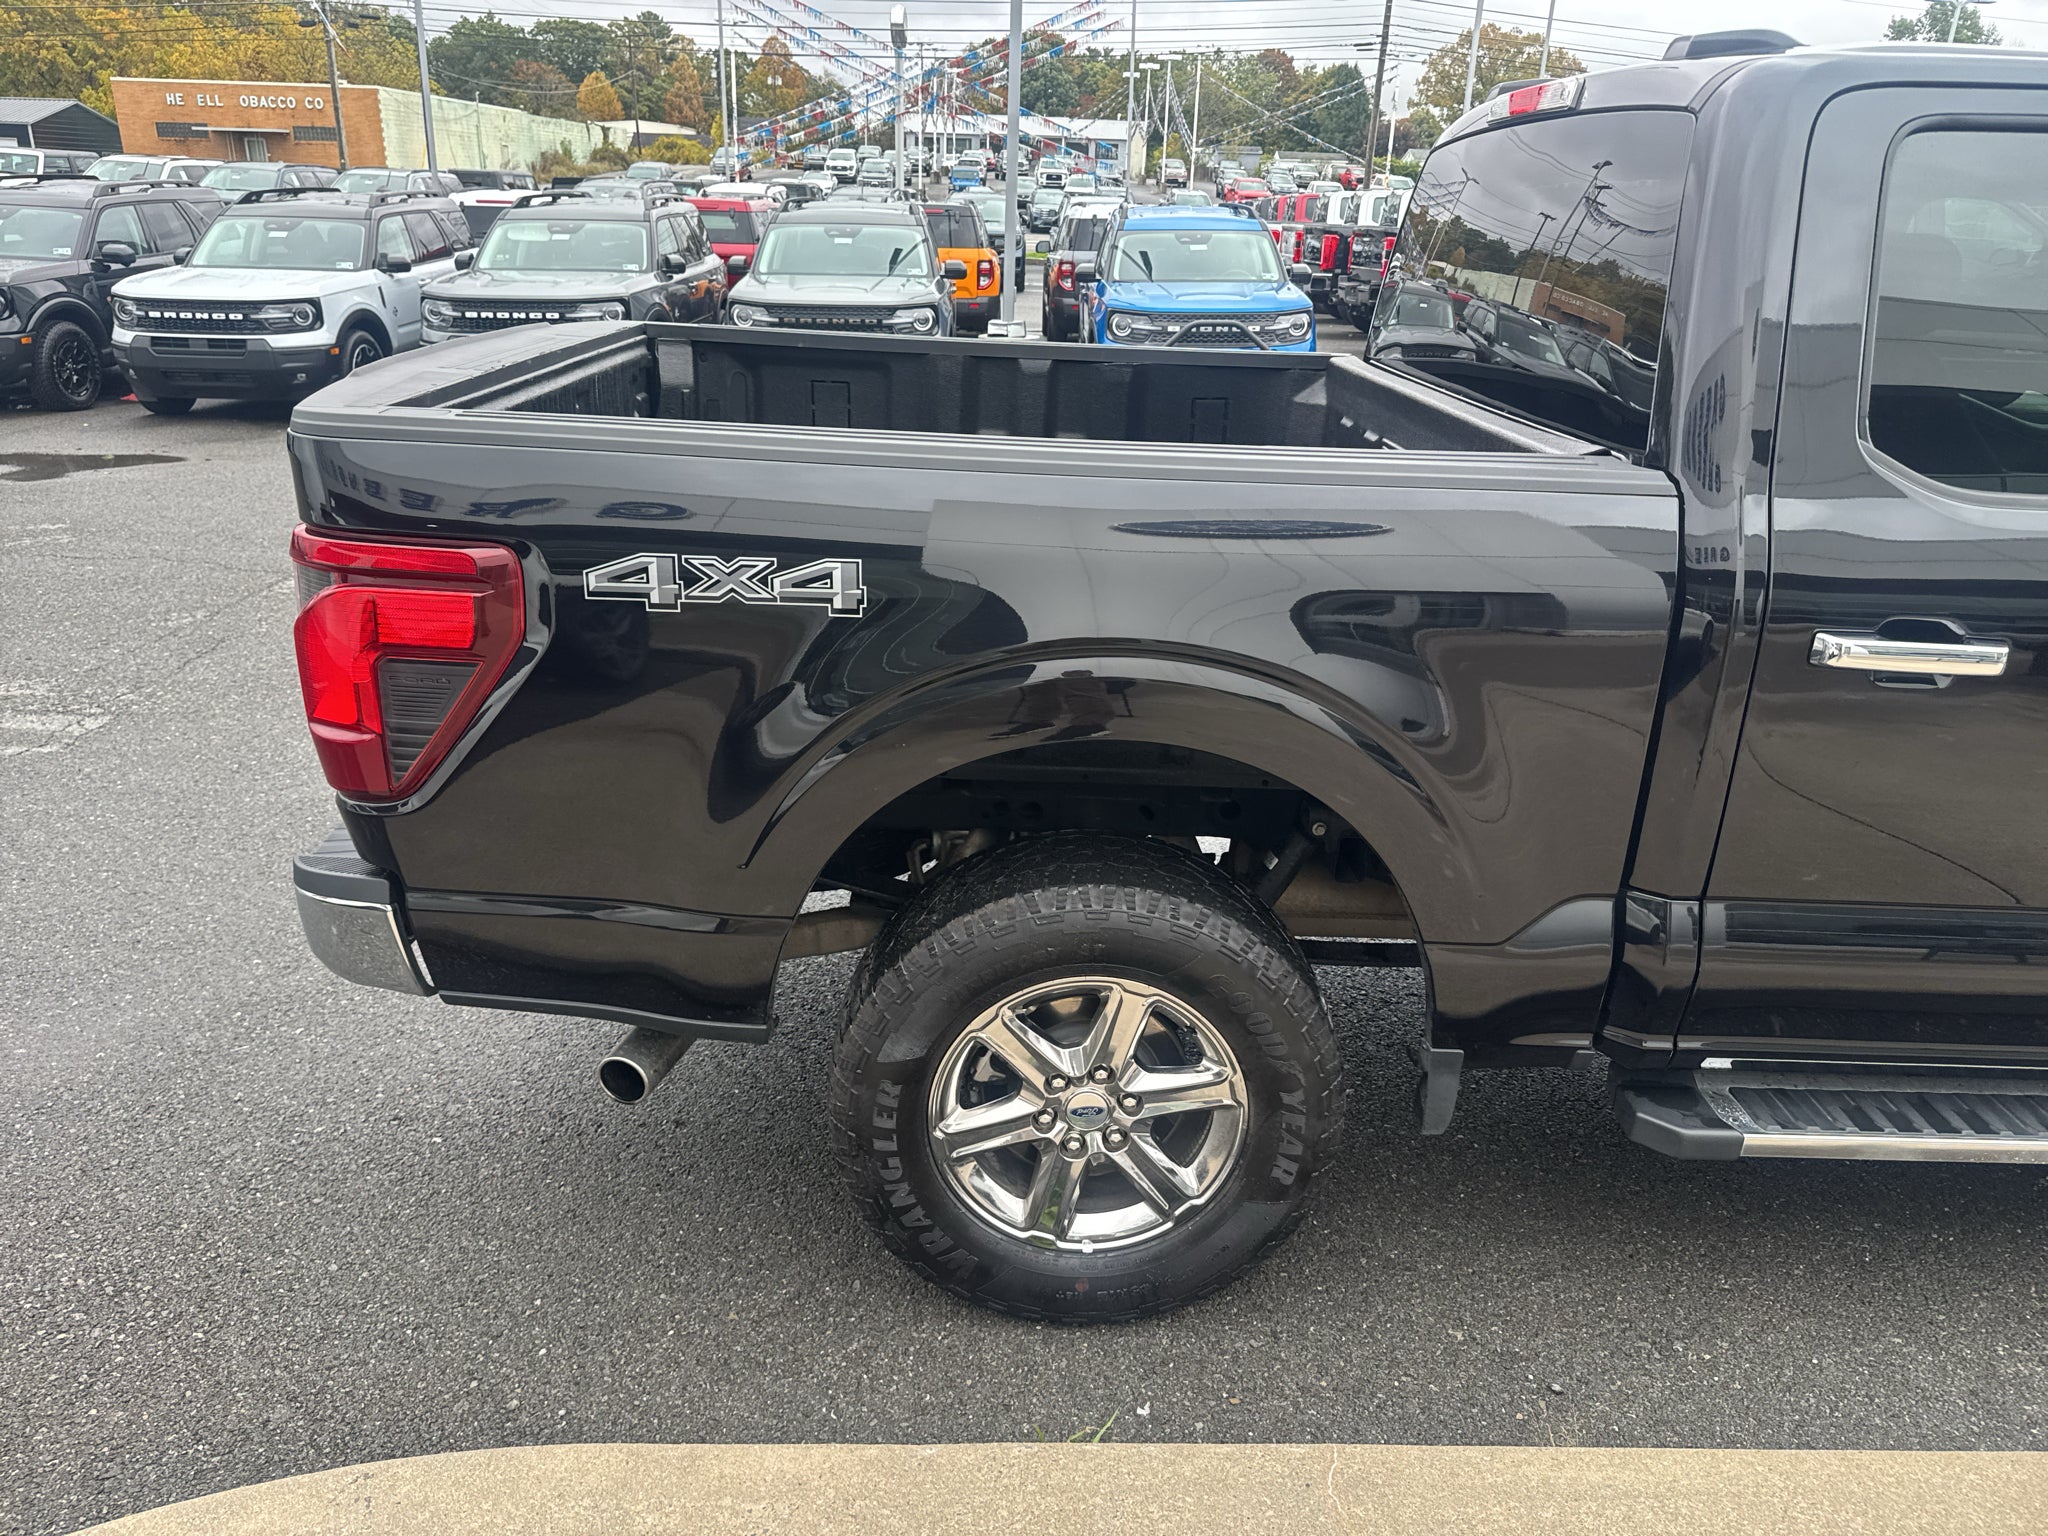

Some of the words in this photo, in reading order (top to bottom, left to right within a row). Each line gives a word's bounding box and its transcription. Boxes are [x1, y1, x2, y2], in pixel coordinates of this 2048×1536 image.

[239, 95, 297, 109] OBACCO
[304, 97, 325, 110] CO
[148, 311, 243, 320] BRONCO
[465, 311, 560, 319] BRONCO
[872, 1079, 980, 1281] WRANGLER
